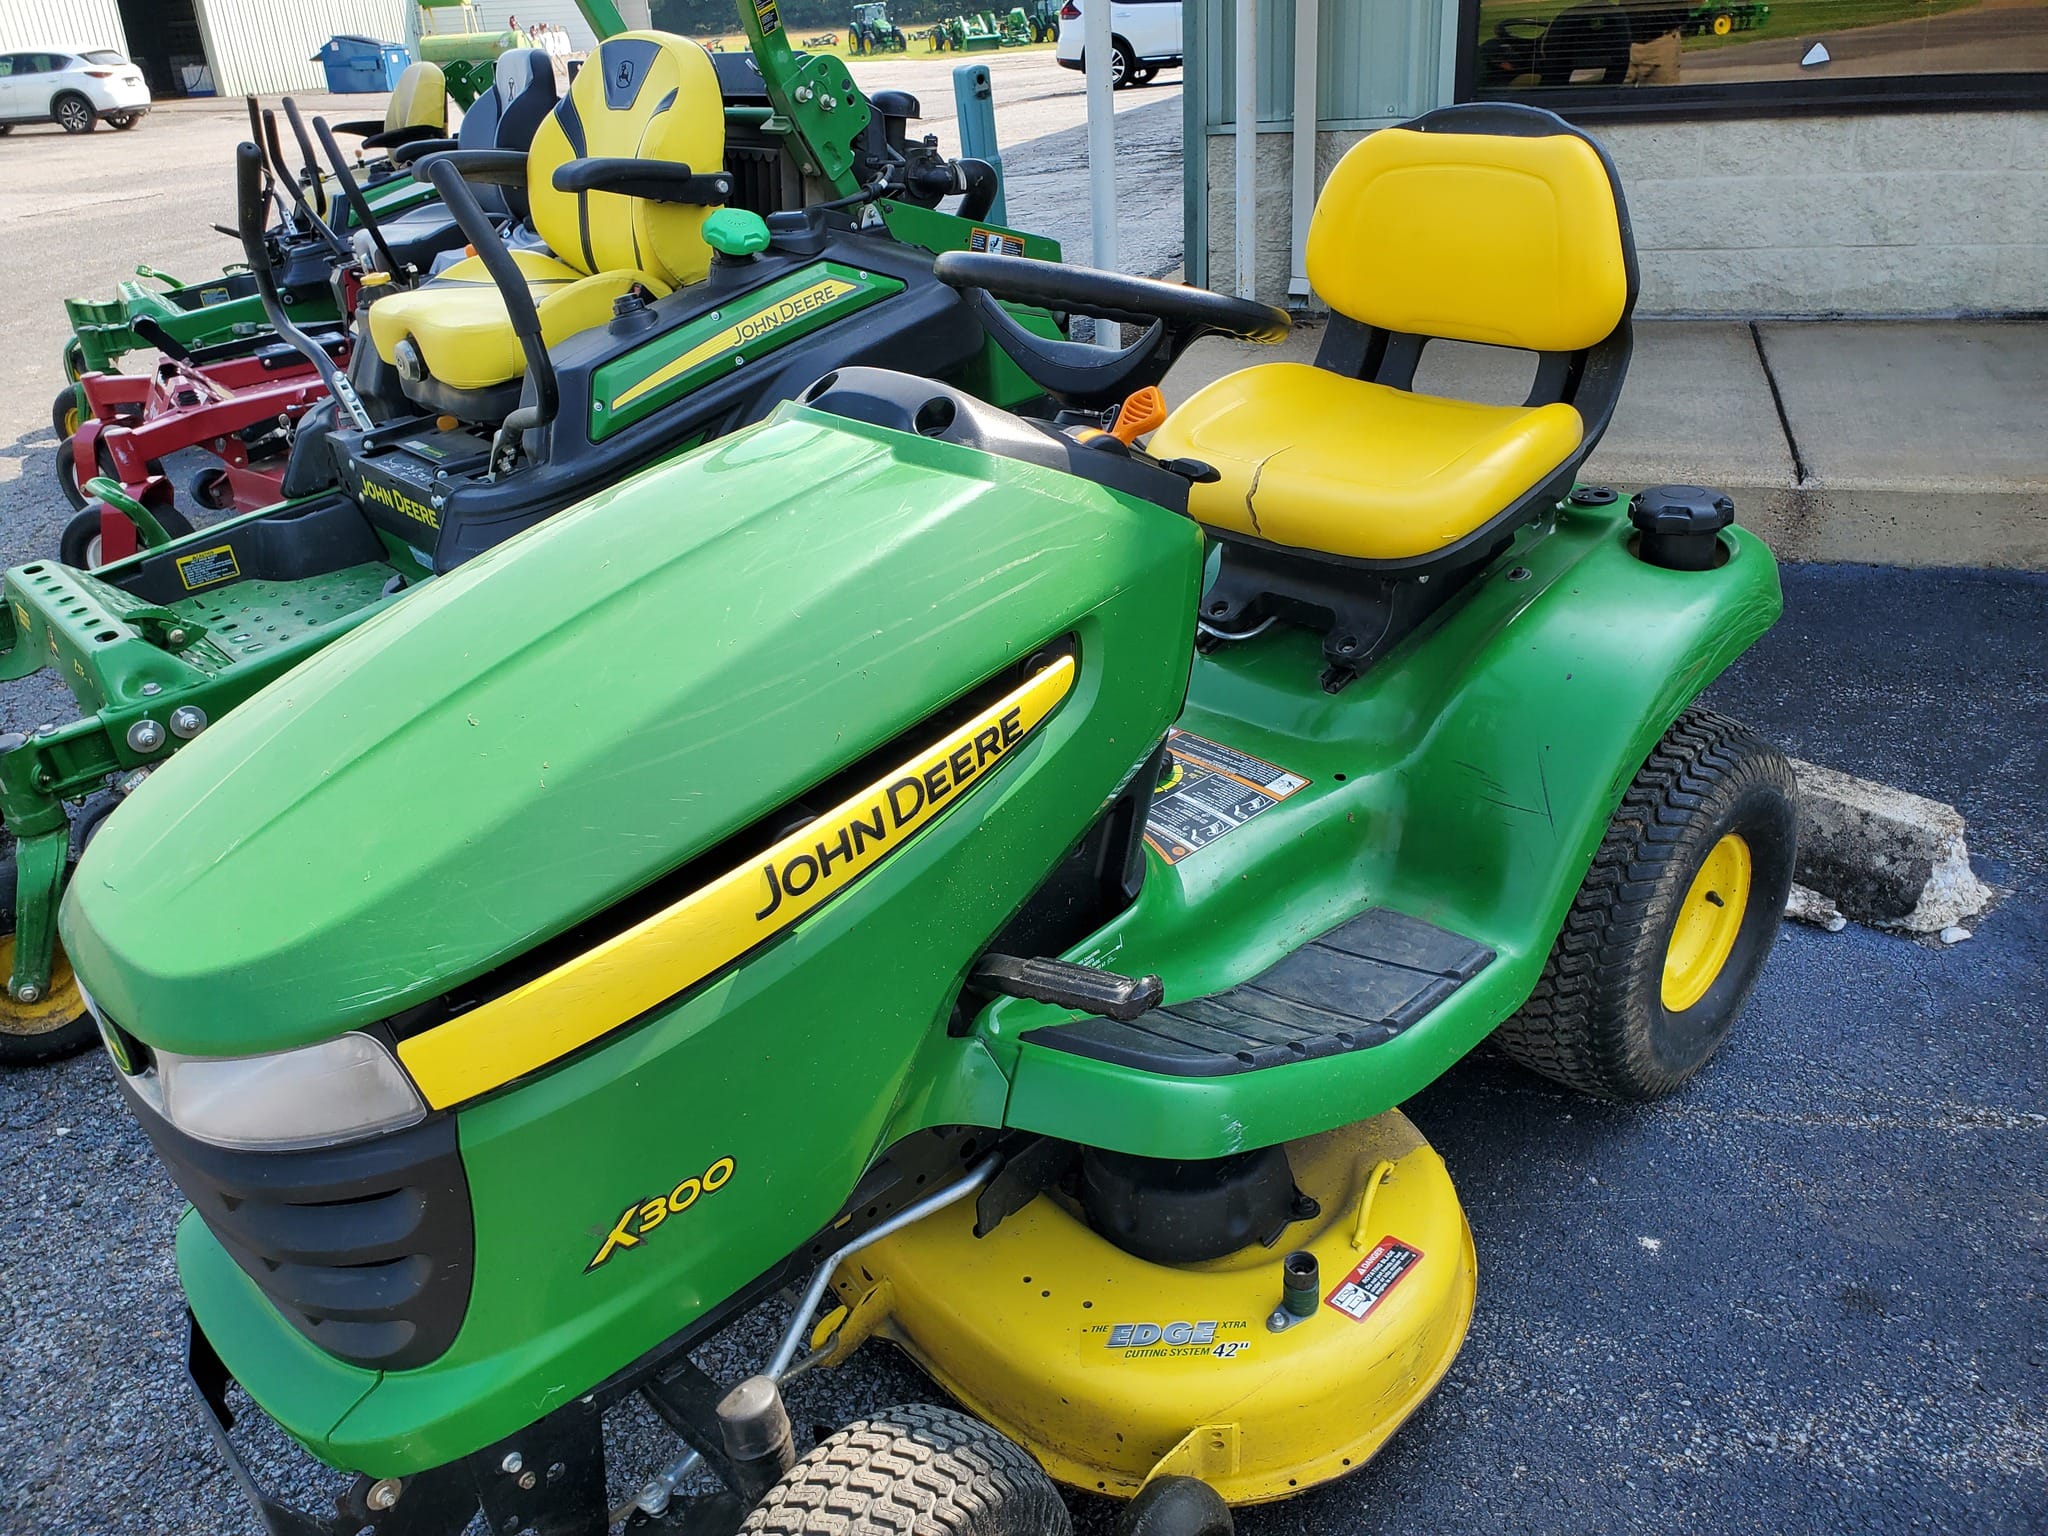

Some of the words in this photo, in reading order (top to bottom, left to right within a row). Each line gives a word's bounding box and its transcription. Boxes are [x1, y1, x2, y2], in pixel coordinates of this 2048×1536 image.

[734, 311, 780, 346] JOHN
[780, 284, 836, 321] DEERE
[361, 474, 395, 509] JOHN
[392, 489, 440, 530] DEERE
[755, 805, 886, 921] JOHN
[886, 705, 1025, 829] DEERE
[583, 1155, 737, 1274] X300
[1362, 1247, 1385, 1269] DANGER
[1090, 1325, 1109, 1333] THE
[1104, 1320, 1219, 1348] EDGE
[1221, 1321, 1247, 1329] XTRA
[1124, 1349, 1167, 1358] CUTTING
[1169, 1348, 1210, 1356] SYSTEM
[1212, 1342, 1249, 1358] 42"
